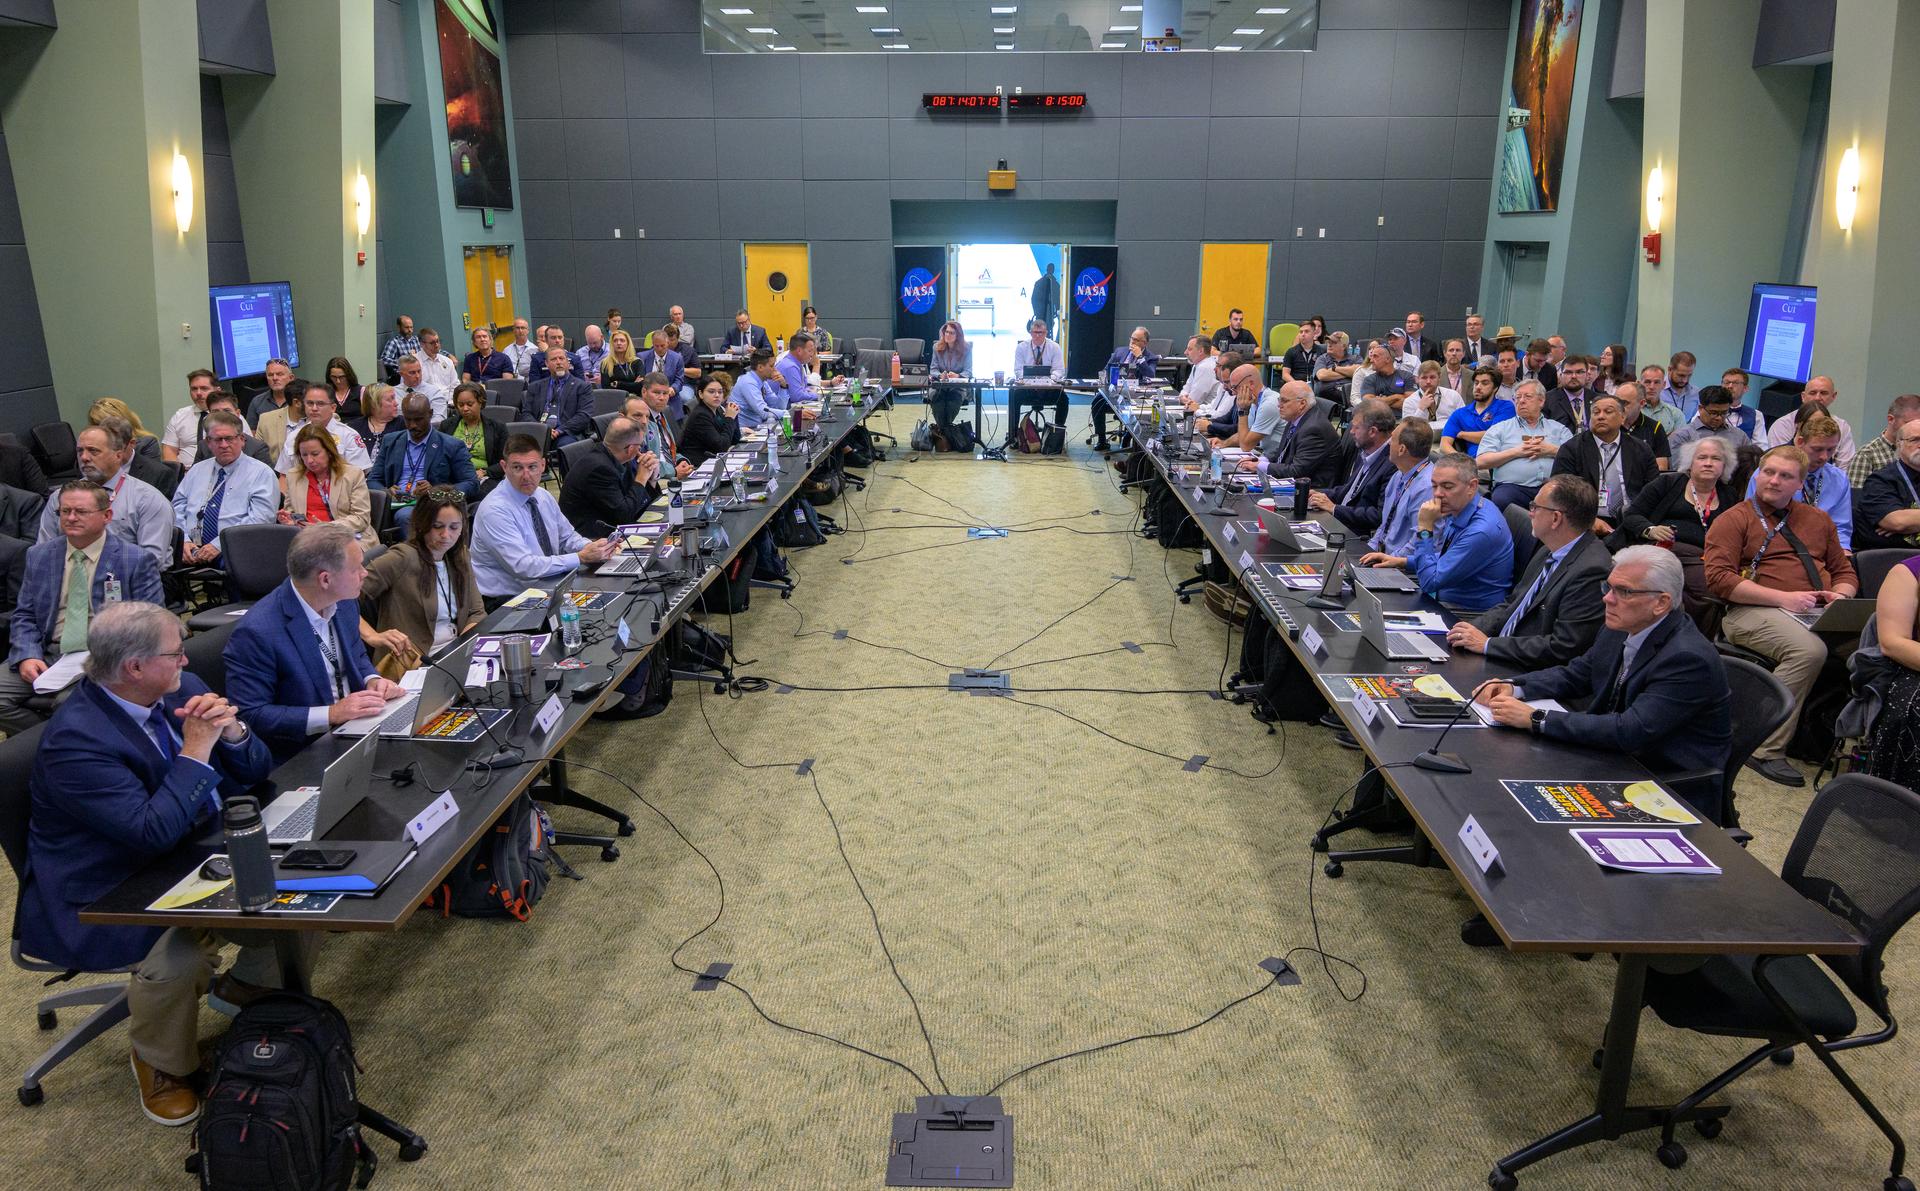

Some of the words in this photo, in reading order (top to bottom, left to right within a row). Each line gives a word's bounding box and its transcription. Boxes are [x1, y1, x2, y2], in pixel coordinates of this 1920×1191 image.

[904, 286, 936, 297] NASA
[1077, 285, 1107, 297] NASA
[1534, 785, 1573, 817] HAPPINESS
[1545, 785, 1579, 812] SAFETY
